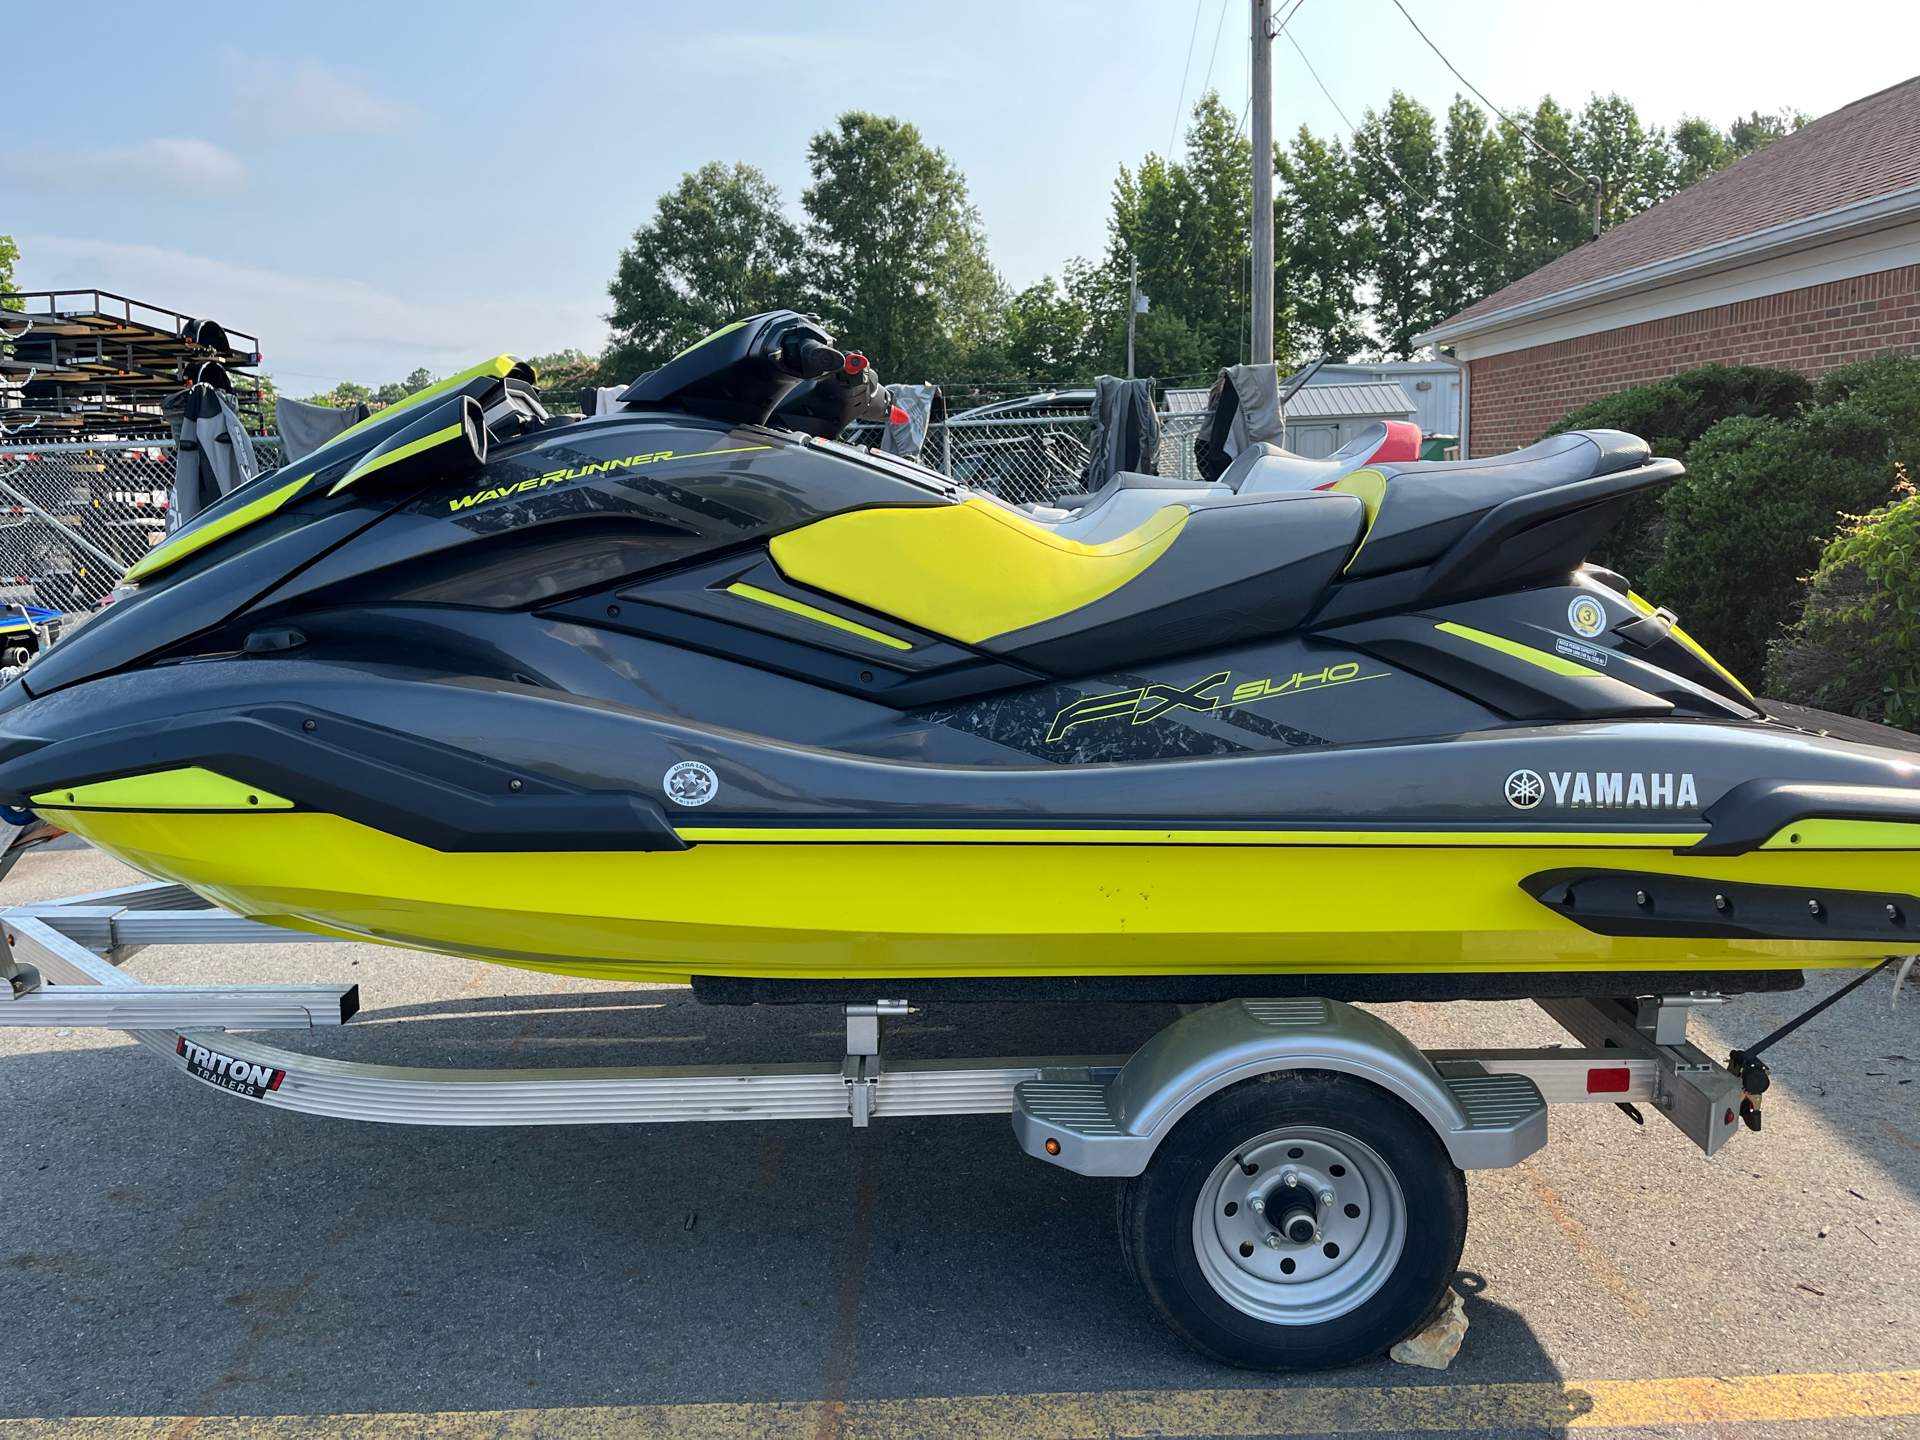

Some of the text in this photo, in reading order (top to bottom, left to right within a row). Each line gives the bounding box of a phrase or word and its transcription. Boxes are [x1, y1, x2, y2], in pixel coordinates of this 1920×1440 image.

[449, 450, 674, 511] WAVERUNNER
[1583, 610, 1592, 621] 3
[1045, 670, 1231, 742] FX
[1548, 772, 1698, 809] YAMAHA
[184, 1040, 273, 1088] TRITON
[197, 1066, 255, 1096] TRAILERS
